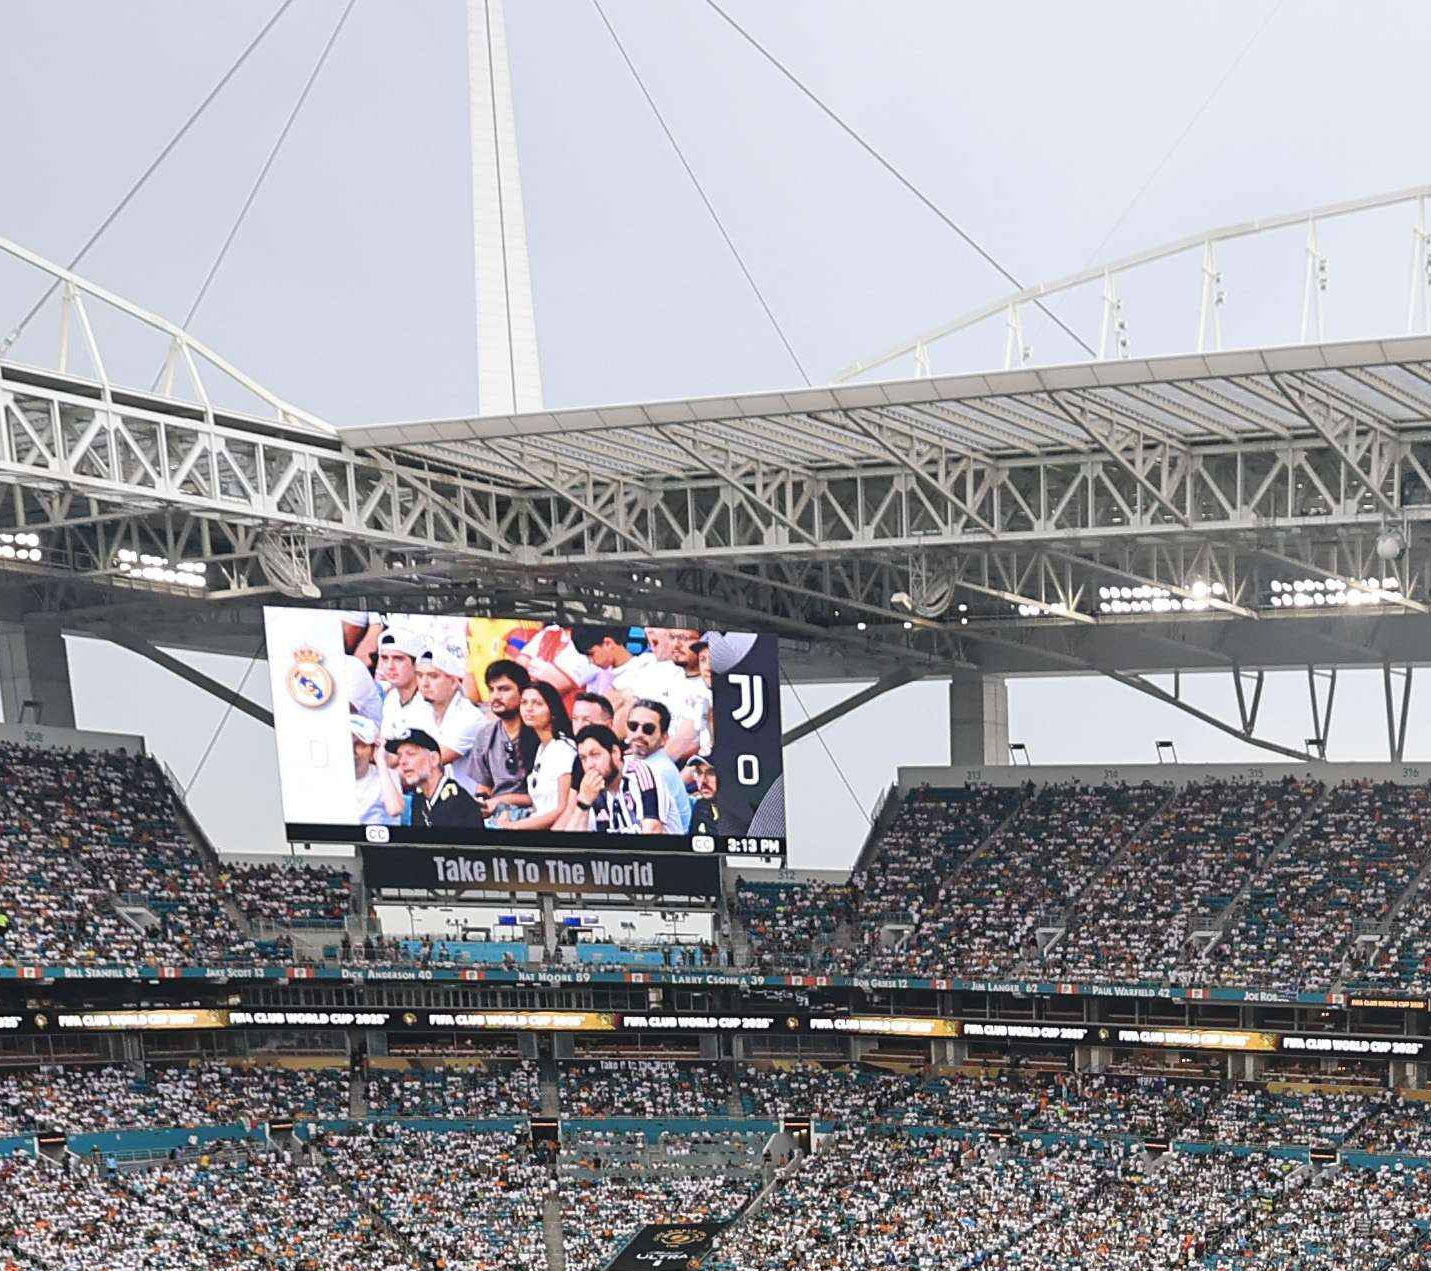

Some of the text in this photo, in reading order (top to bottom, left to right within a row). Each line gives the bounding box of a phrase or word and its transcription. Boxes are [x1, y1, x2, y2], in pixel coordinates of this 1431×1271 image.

[737, 754, 760, 785] 0
[760, 839, 780, 853] PM
[433, 856, 655, 887] Take It To The World
[418, 970, 433, 980] 40
[575, 972, 591, 982] 89
[750, 975, 765, 986] 39
[1025, 982, 1038, 992] 62
[1158, 988, 1171, 997] 42
